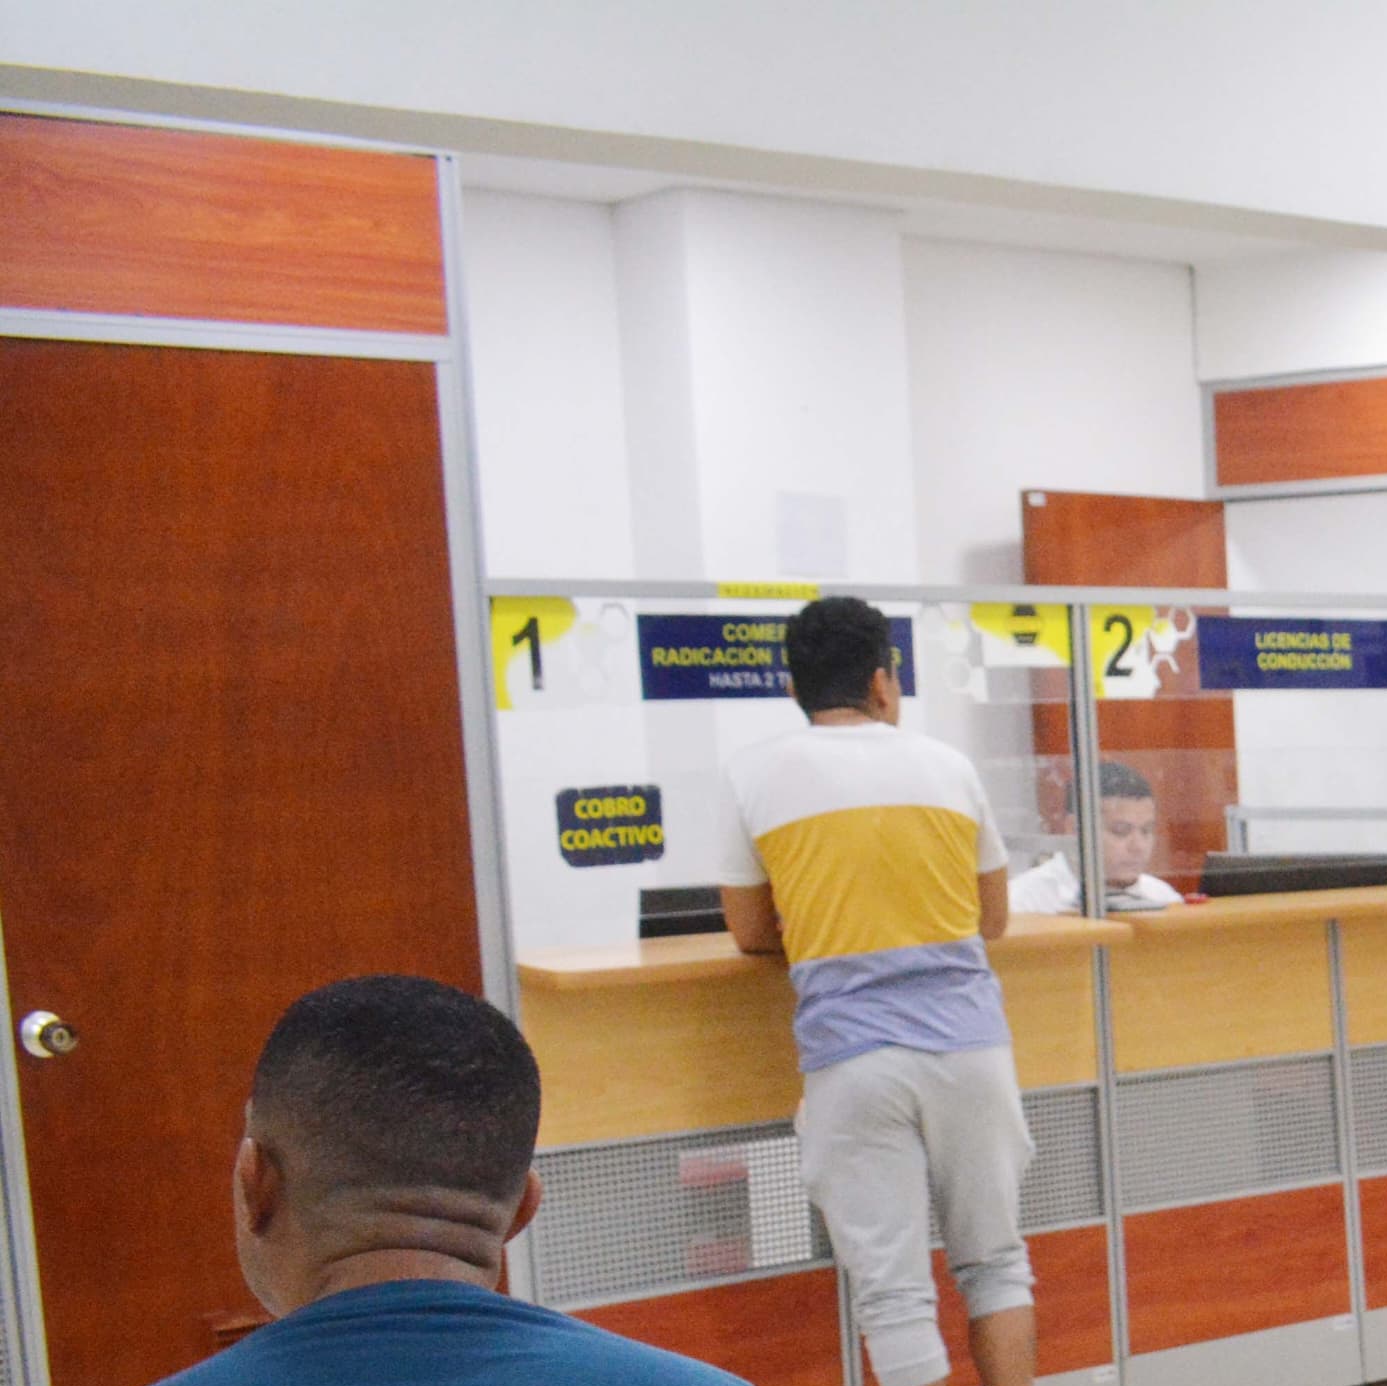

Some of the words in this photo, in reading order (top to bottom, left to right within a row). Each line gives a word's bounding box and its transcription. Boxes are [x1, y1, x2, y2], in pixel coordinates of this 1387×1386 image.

[512, 616, 544, 690] 1
[1104, 614, 1133, 677] 2
[1254, 632, 1330, 650] LICENCIAS
[1332, 632, 1351, 650] DE
[651, 643, 773, 667] RADICACIÓN
[708, 671, 763, 689] HASTA
[573, 795, 647, 821] COBRO
[560, 823, 664, 851] COACTIVO
